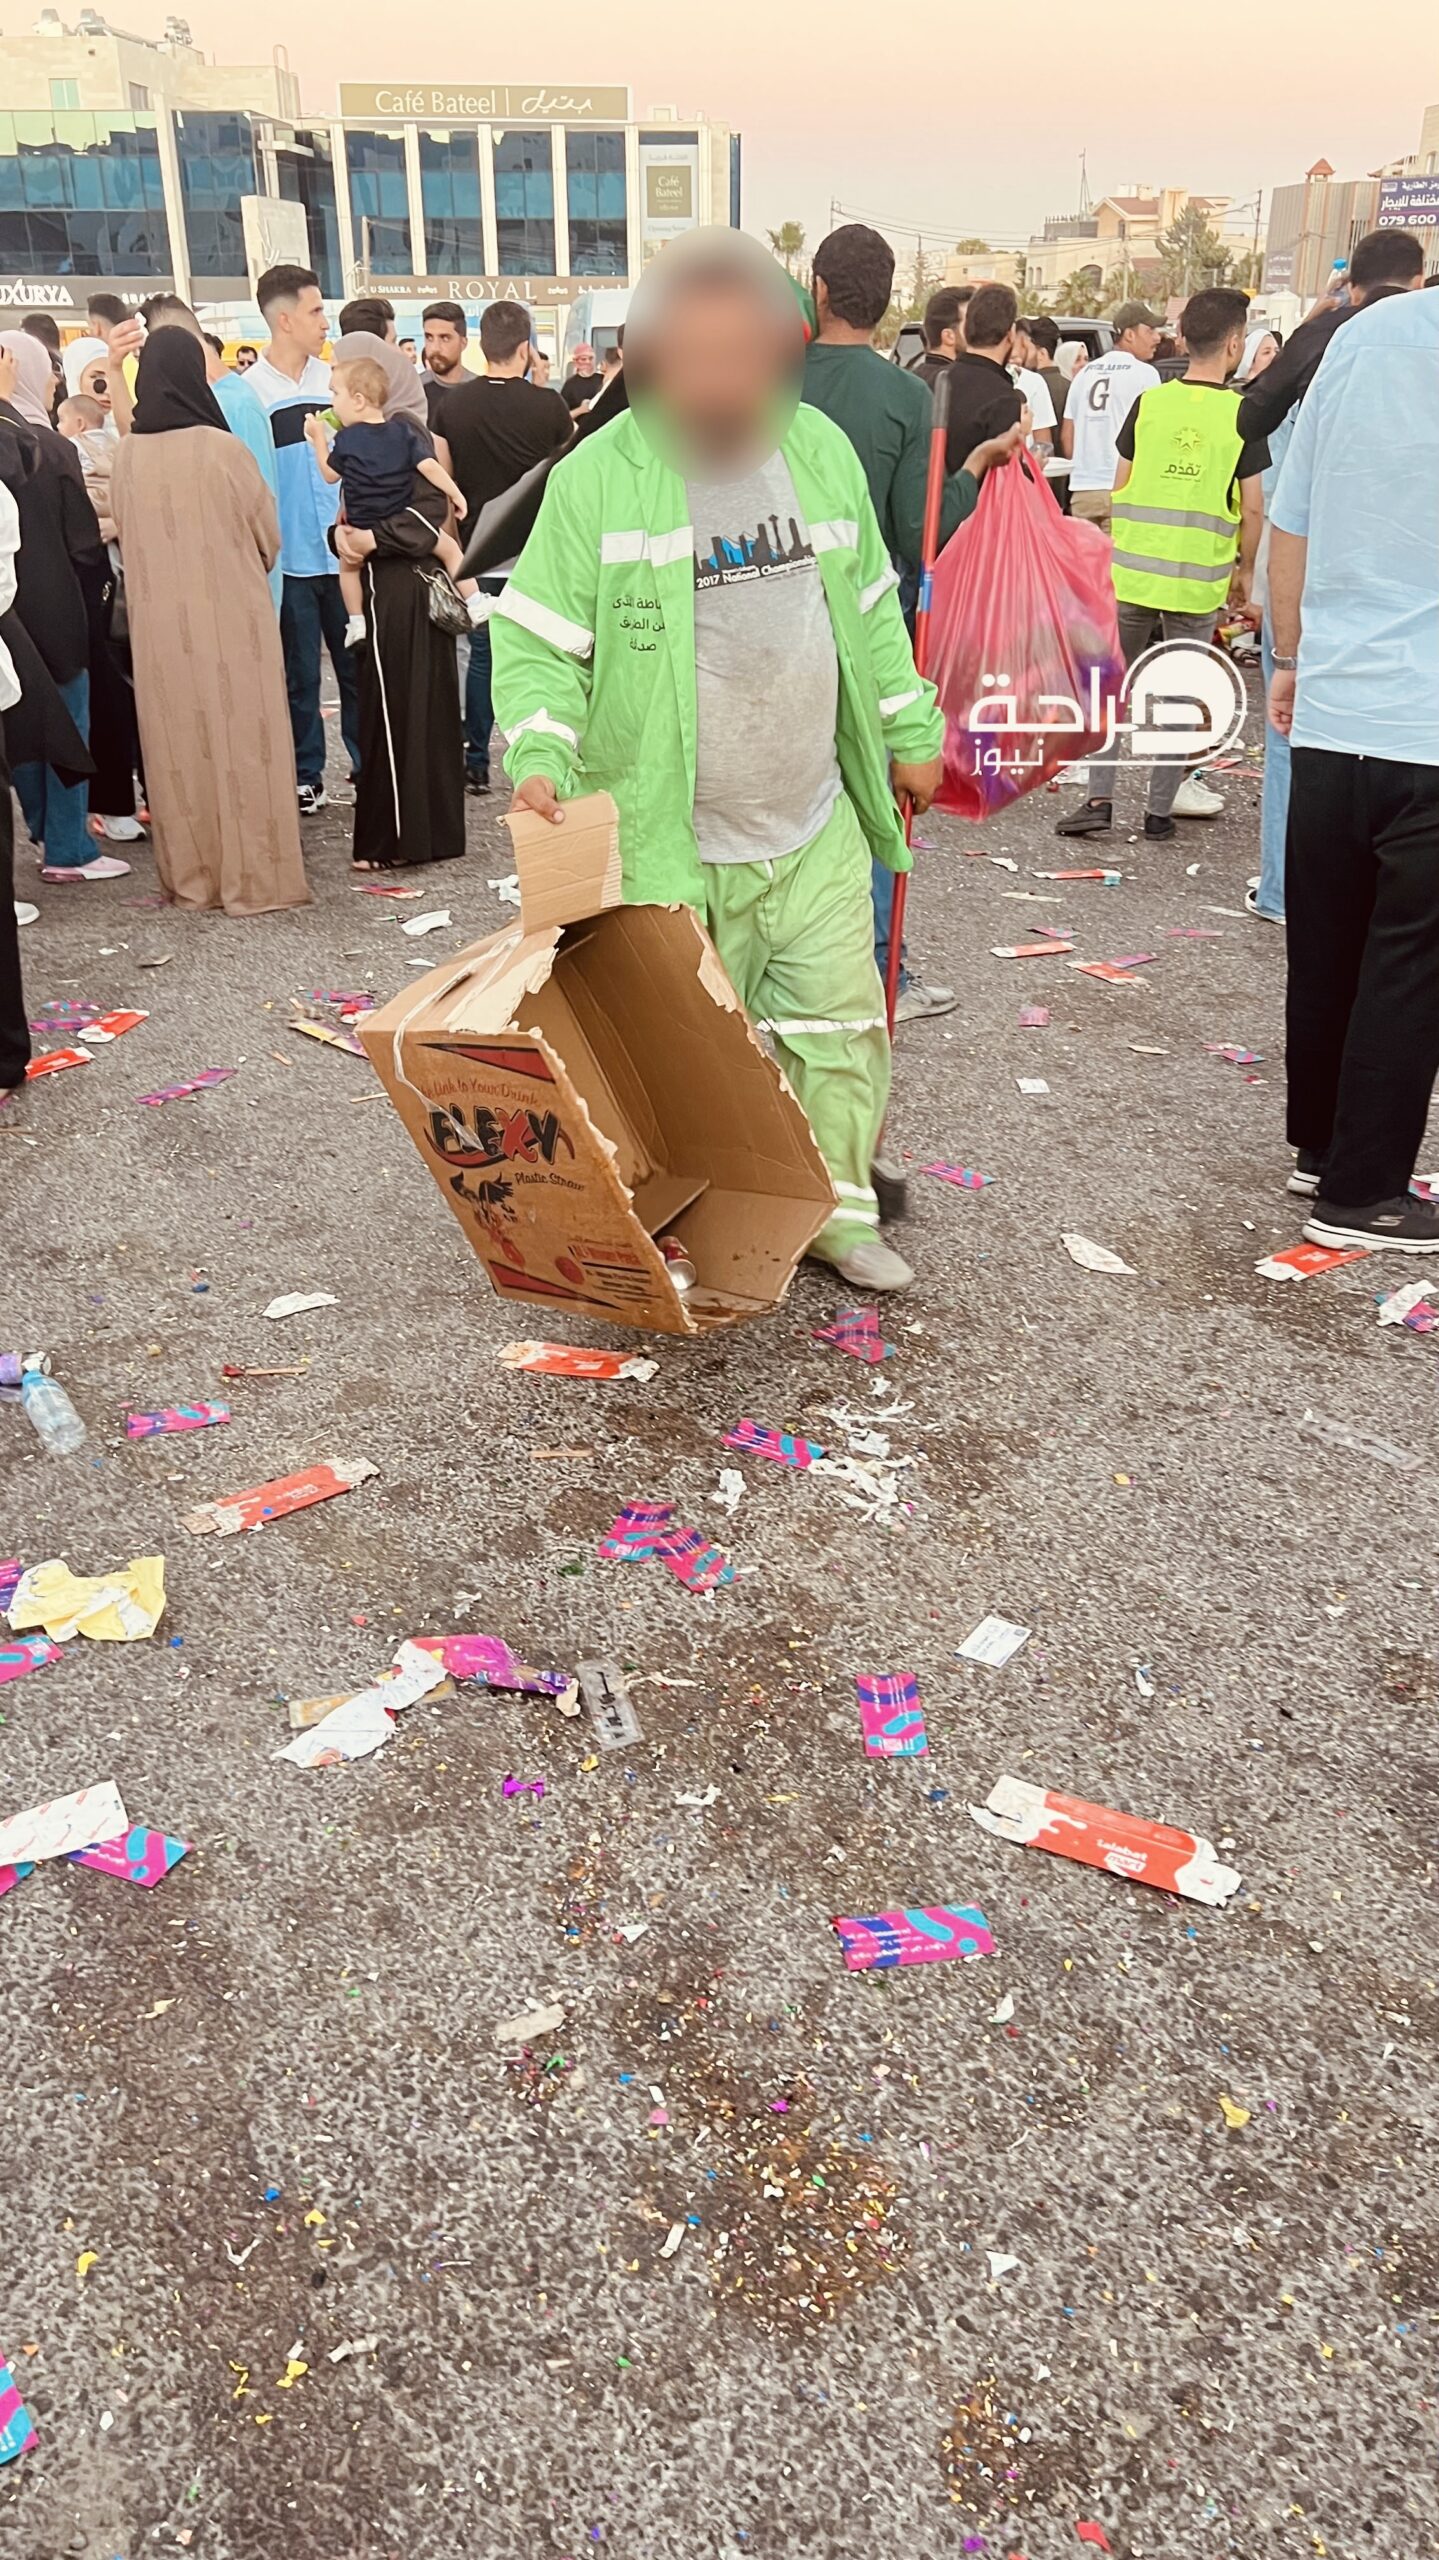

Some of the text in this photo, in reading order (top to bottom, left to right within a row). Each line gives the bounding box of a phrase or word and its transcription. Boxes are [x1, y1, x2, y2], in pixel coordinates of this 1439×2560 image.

[375, 89, 496, 114] Café Bateel
[521, 89, 593, 115] بتيل
[658, 175, 680, 187] Café
[656, 186, 683, 198] Bateel
[1379, 214, 1437, 226] 079 600
[448, 281, 538, 300] ROYAL
[1088, 377, 1110, 411] G
[696, 575, 720, 589] 2017
[723, 568, 760, 584] National
[433, 1078, 458, 1097] Link
[469, 1078, 498, 1097] Your
[514, 1172, 549, 1186] Plastic
[1096, 1839, 1148, 1863] talabat
